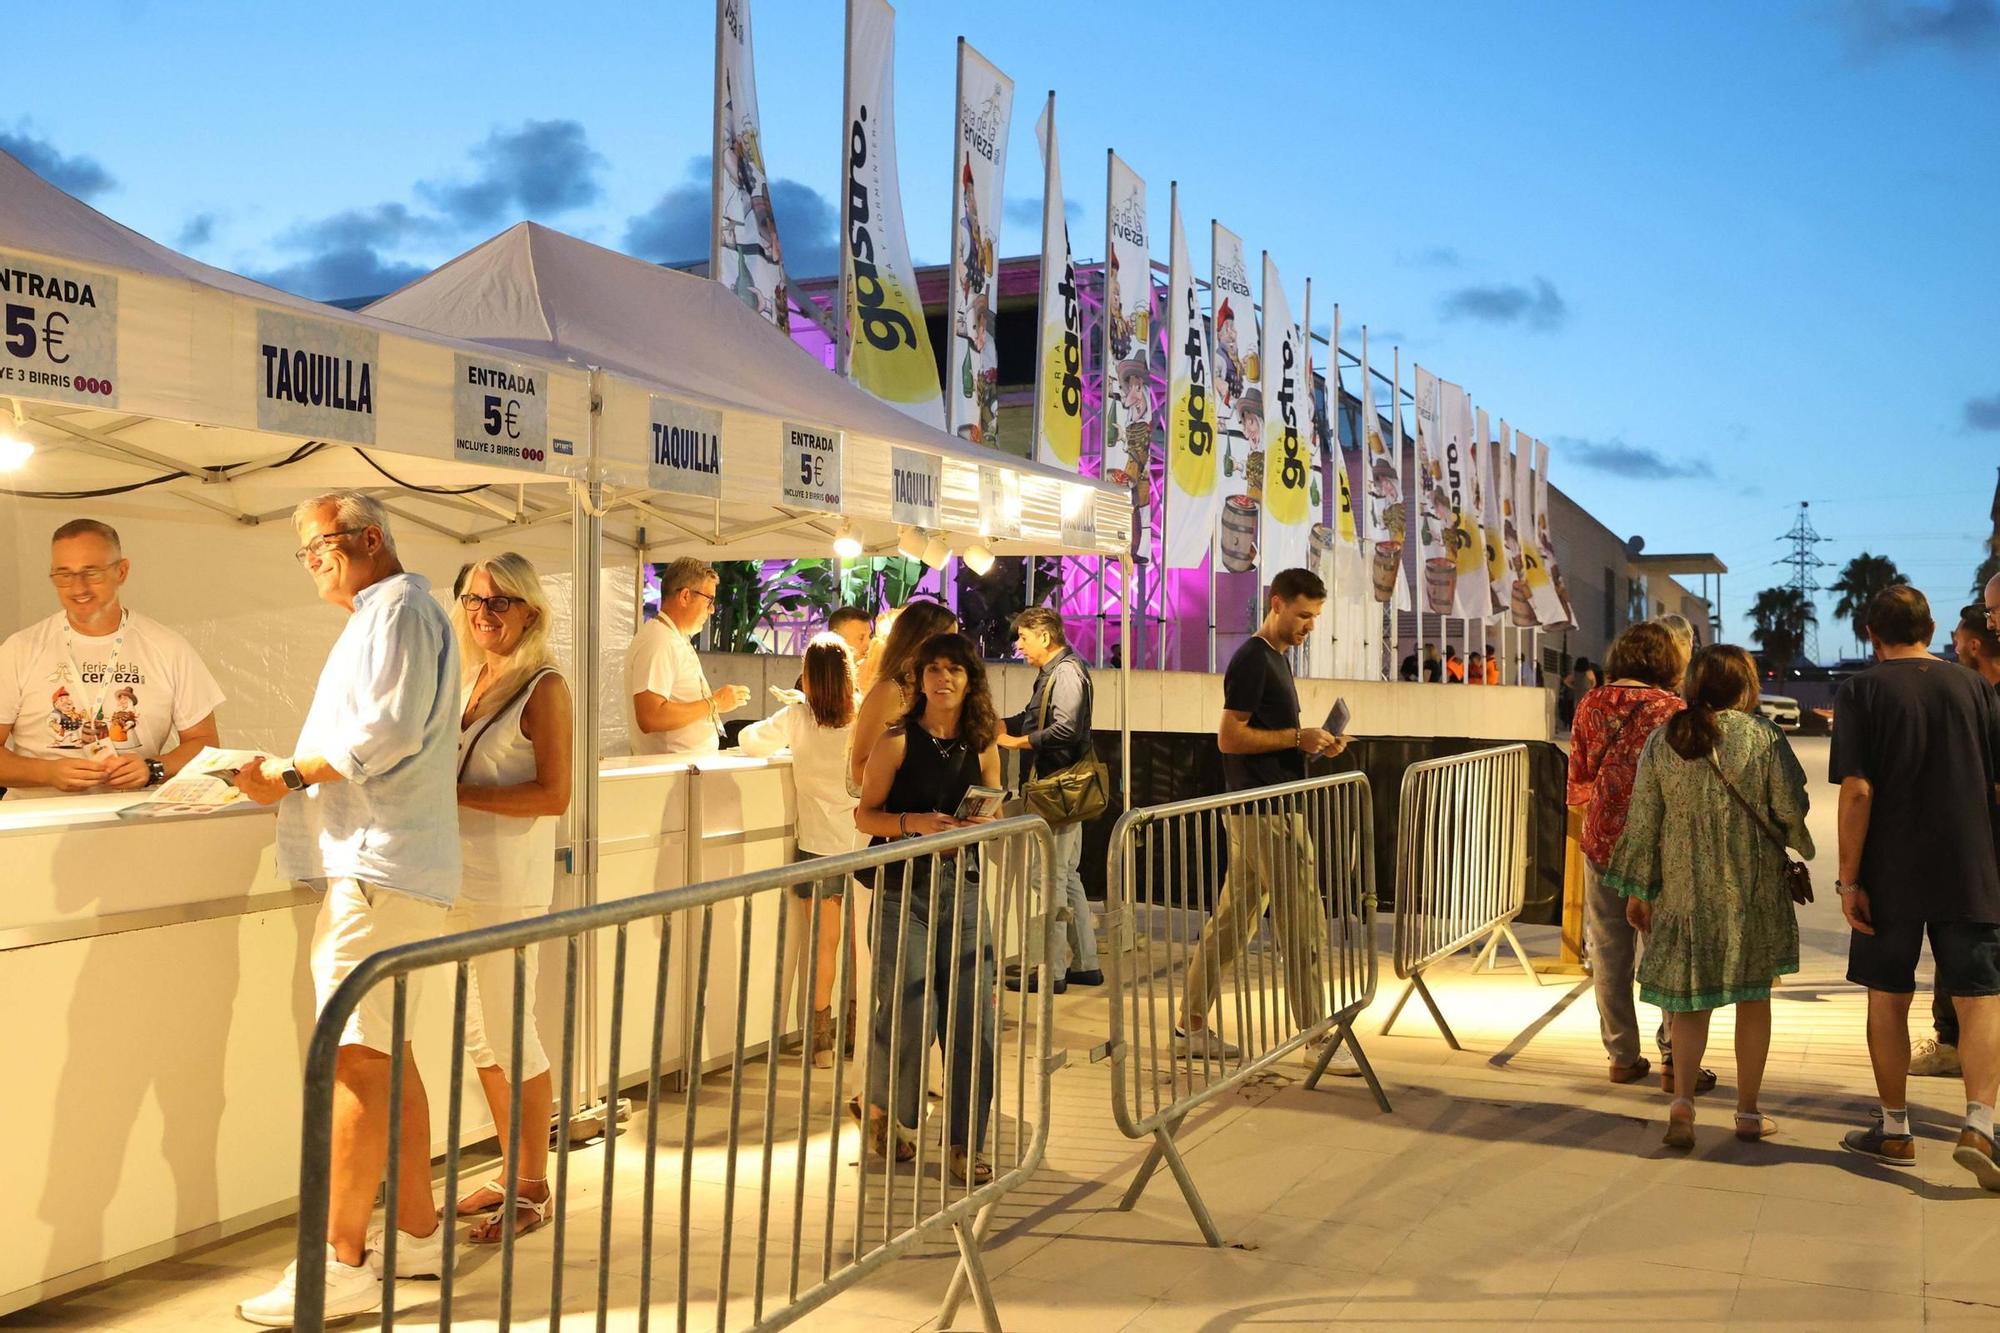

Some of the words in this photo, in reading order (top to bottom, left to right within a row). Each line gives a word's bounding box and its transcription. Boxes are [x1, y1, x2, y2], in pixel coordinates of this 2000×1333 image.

[961, 118, 993, 160] erveza
[6, 303, 69, 364] 5€
[18, 369, 25, 382] 3
[29, 371, 71, 388] BIRRIS
[262, 344, 373, 414] TAQUILLA
[468, 366, 535, 396] ENTRADA
[484, 395, 520, 439] 5€
[456, 438, 489, 453] INCLUYE
[490, 444, 495, 454] 3
[496, 445, 520, 457] BIRRIS
[652, 422, 720, 475] TAQUILLA
[791, 430, 834, 453] ENTRADA
[82, 661, 107, 673] feria
[129, 662, 139, 674] la
